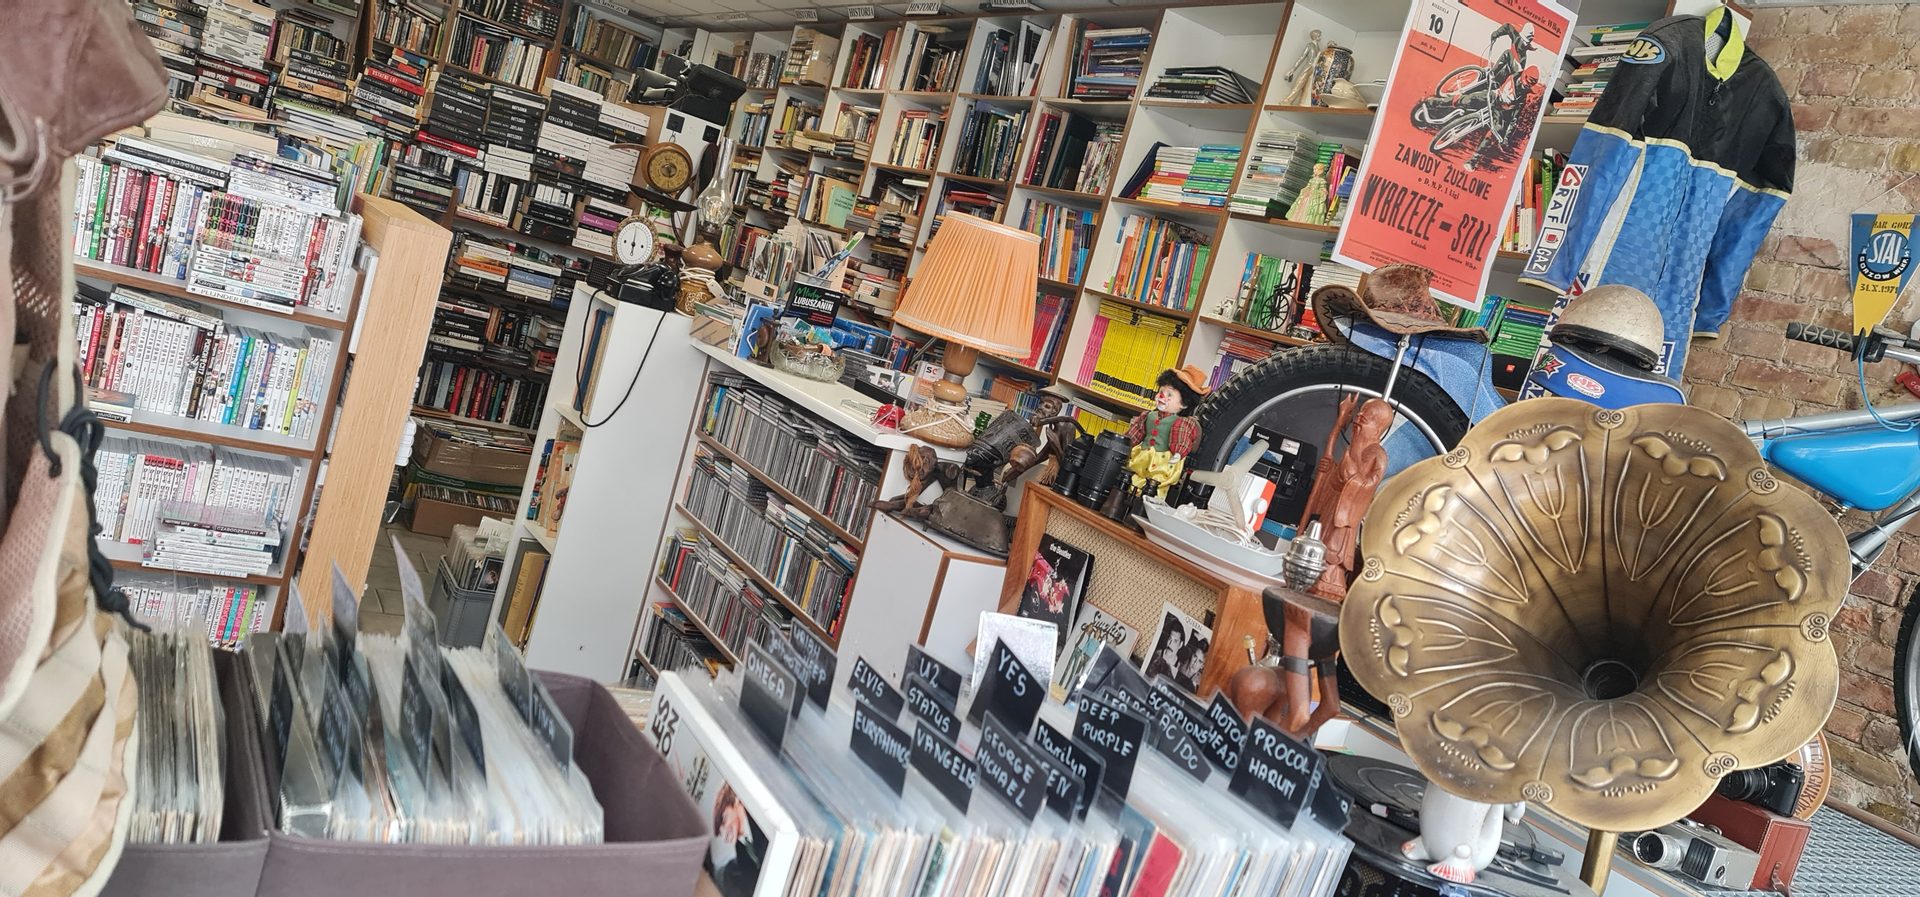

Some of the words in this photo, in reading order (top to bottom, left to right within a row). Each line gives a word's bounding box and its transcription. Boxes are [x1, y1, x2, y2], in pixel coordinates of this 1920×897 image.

[848, 7, 874, 18] HISTORIA
[908, 2, 940, 12] HISTORIA
[1428, 14, 1444, 35] 10
[1394, 143, 1441, 178] ZAWODY
[1360, 173, 1444, 242] WYBRZEŻE
[1450, 213, 1491, 262] STAL
[335, 229, 345, 253] GOLDEN
[1867, 233, 1903, 265] STAL
[1531, 248, 1552, 272] GAZ
[1859, 256, 1890, 280] GORZÓW
[199, 288, 250, 303] PLUNDERER
[793, 296, 834, 312] LUBUSZANIN
[136, 327, 147, 361] Noragami
[143, 328, 155, 363] Noragami
[151, 330, 163, 364] Noragami
[159, 332, 171, 365] Noragami
[168, 333, 179, 367] Noragami
[176, 334, 188, 369] Noragami
[201, 338, 210, 358] POISON
[746, 651, 786, 701] OMEGA
[853, 660, 885, 698] ELVIS
[919, 657, 940, 689] U2
[997, 648, 1027, 697] YES
[908, 686, 951, 734] STATUS
[1079, 697, 1120, 725] DEEP
[983, 725, 1035, 784] GEORGE
[1037, 725, 1087, 777] Marilyn
[1082, 722, 1134, 757] PURPLE
[1207, 726, 1238, 770] HEAD
[1253, 727, 1312, 776] PROCOL
[916, 727, 976, 787] VANGELIS
[976, 747, 1024, 808] MICHAEL
[1249, 756, 1297, 801] HARUM
